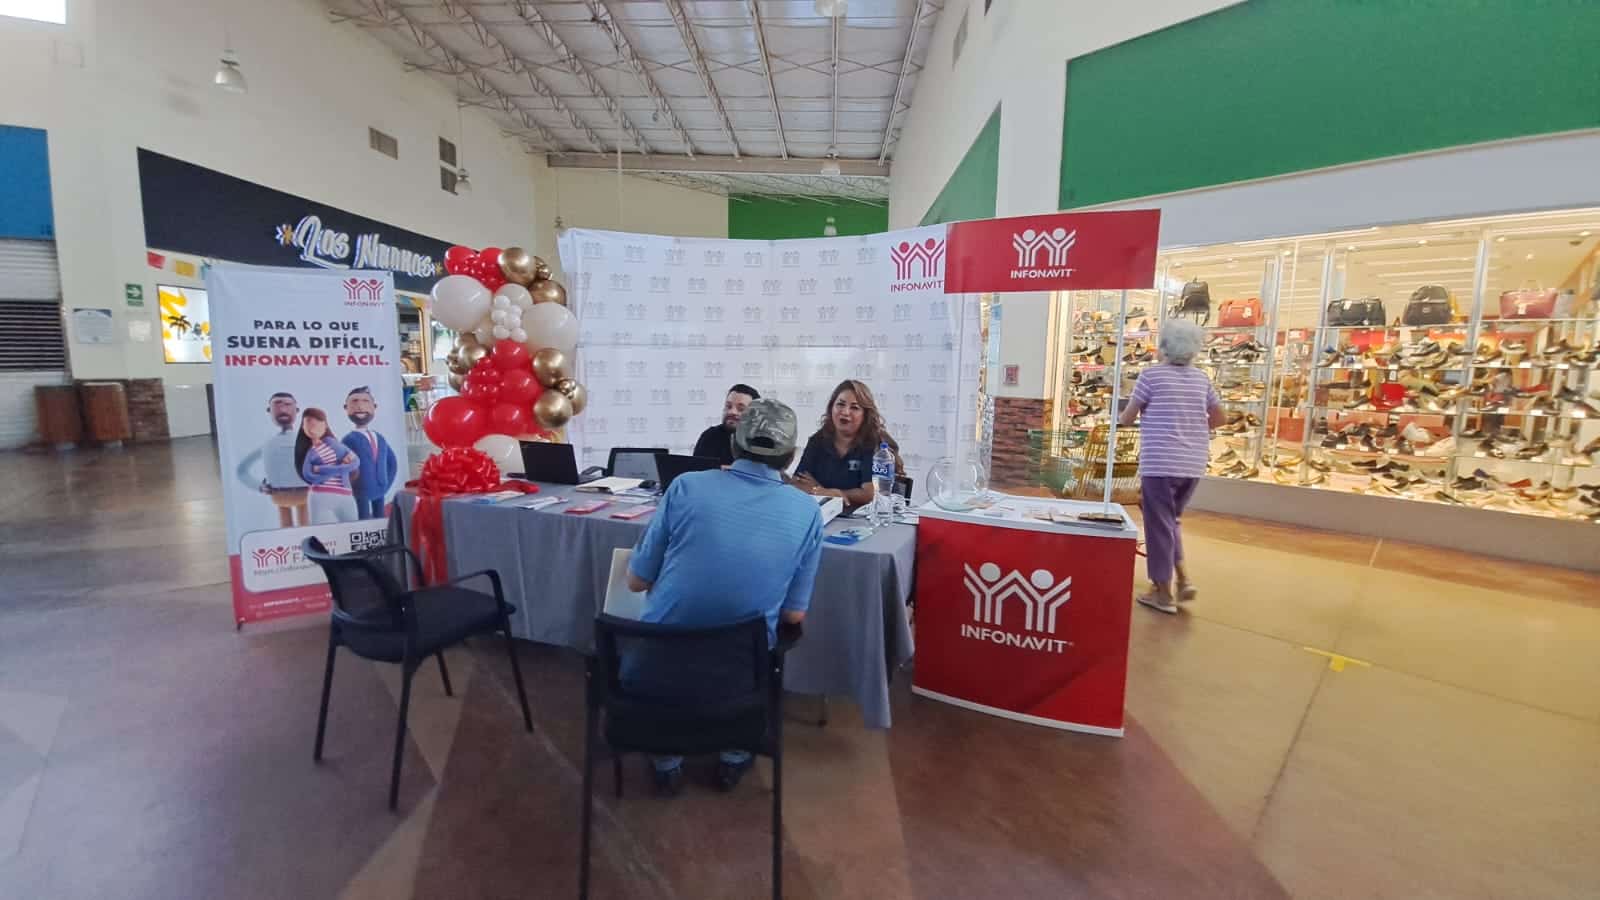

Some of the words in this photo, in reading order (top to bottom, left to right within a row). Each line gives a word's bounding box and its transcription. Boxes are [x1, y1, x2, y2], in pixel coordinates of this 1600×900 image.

[1010, 268, 1073, 279] INFONAVIT
[890, 280, 944, 293] INFONAVIT
[253, 319, 296, 331] PARA
[303, 320, 323, 331] LO
[329, 321, 359, 332] QUE
[227, 335, 300, 349] SUENA
[309, 333, 385, 351] DIFÍCIL,
[225, 354, 329, 367] INFONAVIT
[337, 352, 390, 366] FÁCIL.
[961, 623, 1068, 653] INFONAVIT
